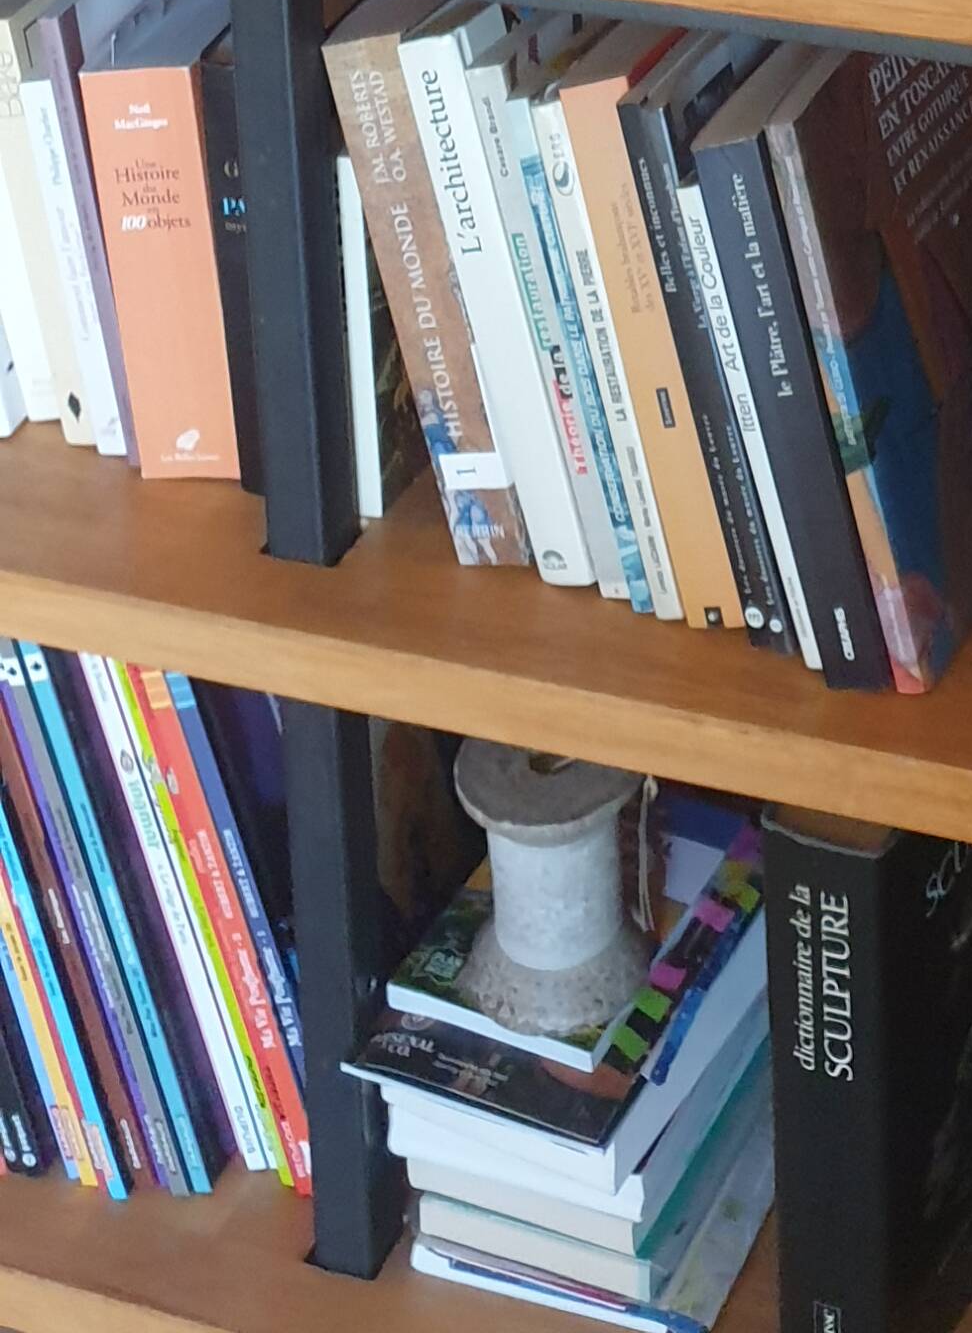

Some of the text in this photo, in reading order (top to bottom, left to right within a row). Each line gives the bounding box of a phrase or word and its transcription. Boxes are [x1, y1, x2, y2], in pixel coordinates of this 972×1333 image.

[349, 69, 378, 148] ROBERTS
[368, 71, 397, 143] WESTAD
[879, 99, 901, 141] EN
[114, 167, 180, 184] Histoire
[420, 69, 483, 255] L'architecture
[886, 125, 916, 167] ENTRE
[121, 214, 192, 232] 100 objets
[122, 189, 180, 207] Monde
[638, 157, 677, 293] Belles et inconnues
[729, 173, 756, 237] matière
[741, 241, 761, 258] la
[750, 261, 766, 279] et
[391, 202, 463, 441] HISTOIRE DU MONDE
[514, 235, 553, 346] restauration
[688, 216, 757, 433] Itten Art de la Couleur
[754, 282, 777, 319] l'art
[575, 248, 627, 422] LA RESTAURATION DE LA PIERRE
[551, 352, 586, 469] Théorie de la
[777, 381, 794, 398] le
[787, 884, 815, 1071] dictionnaire de la
[820, 893, 851, 1081] SCULPTURE
